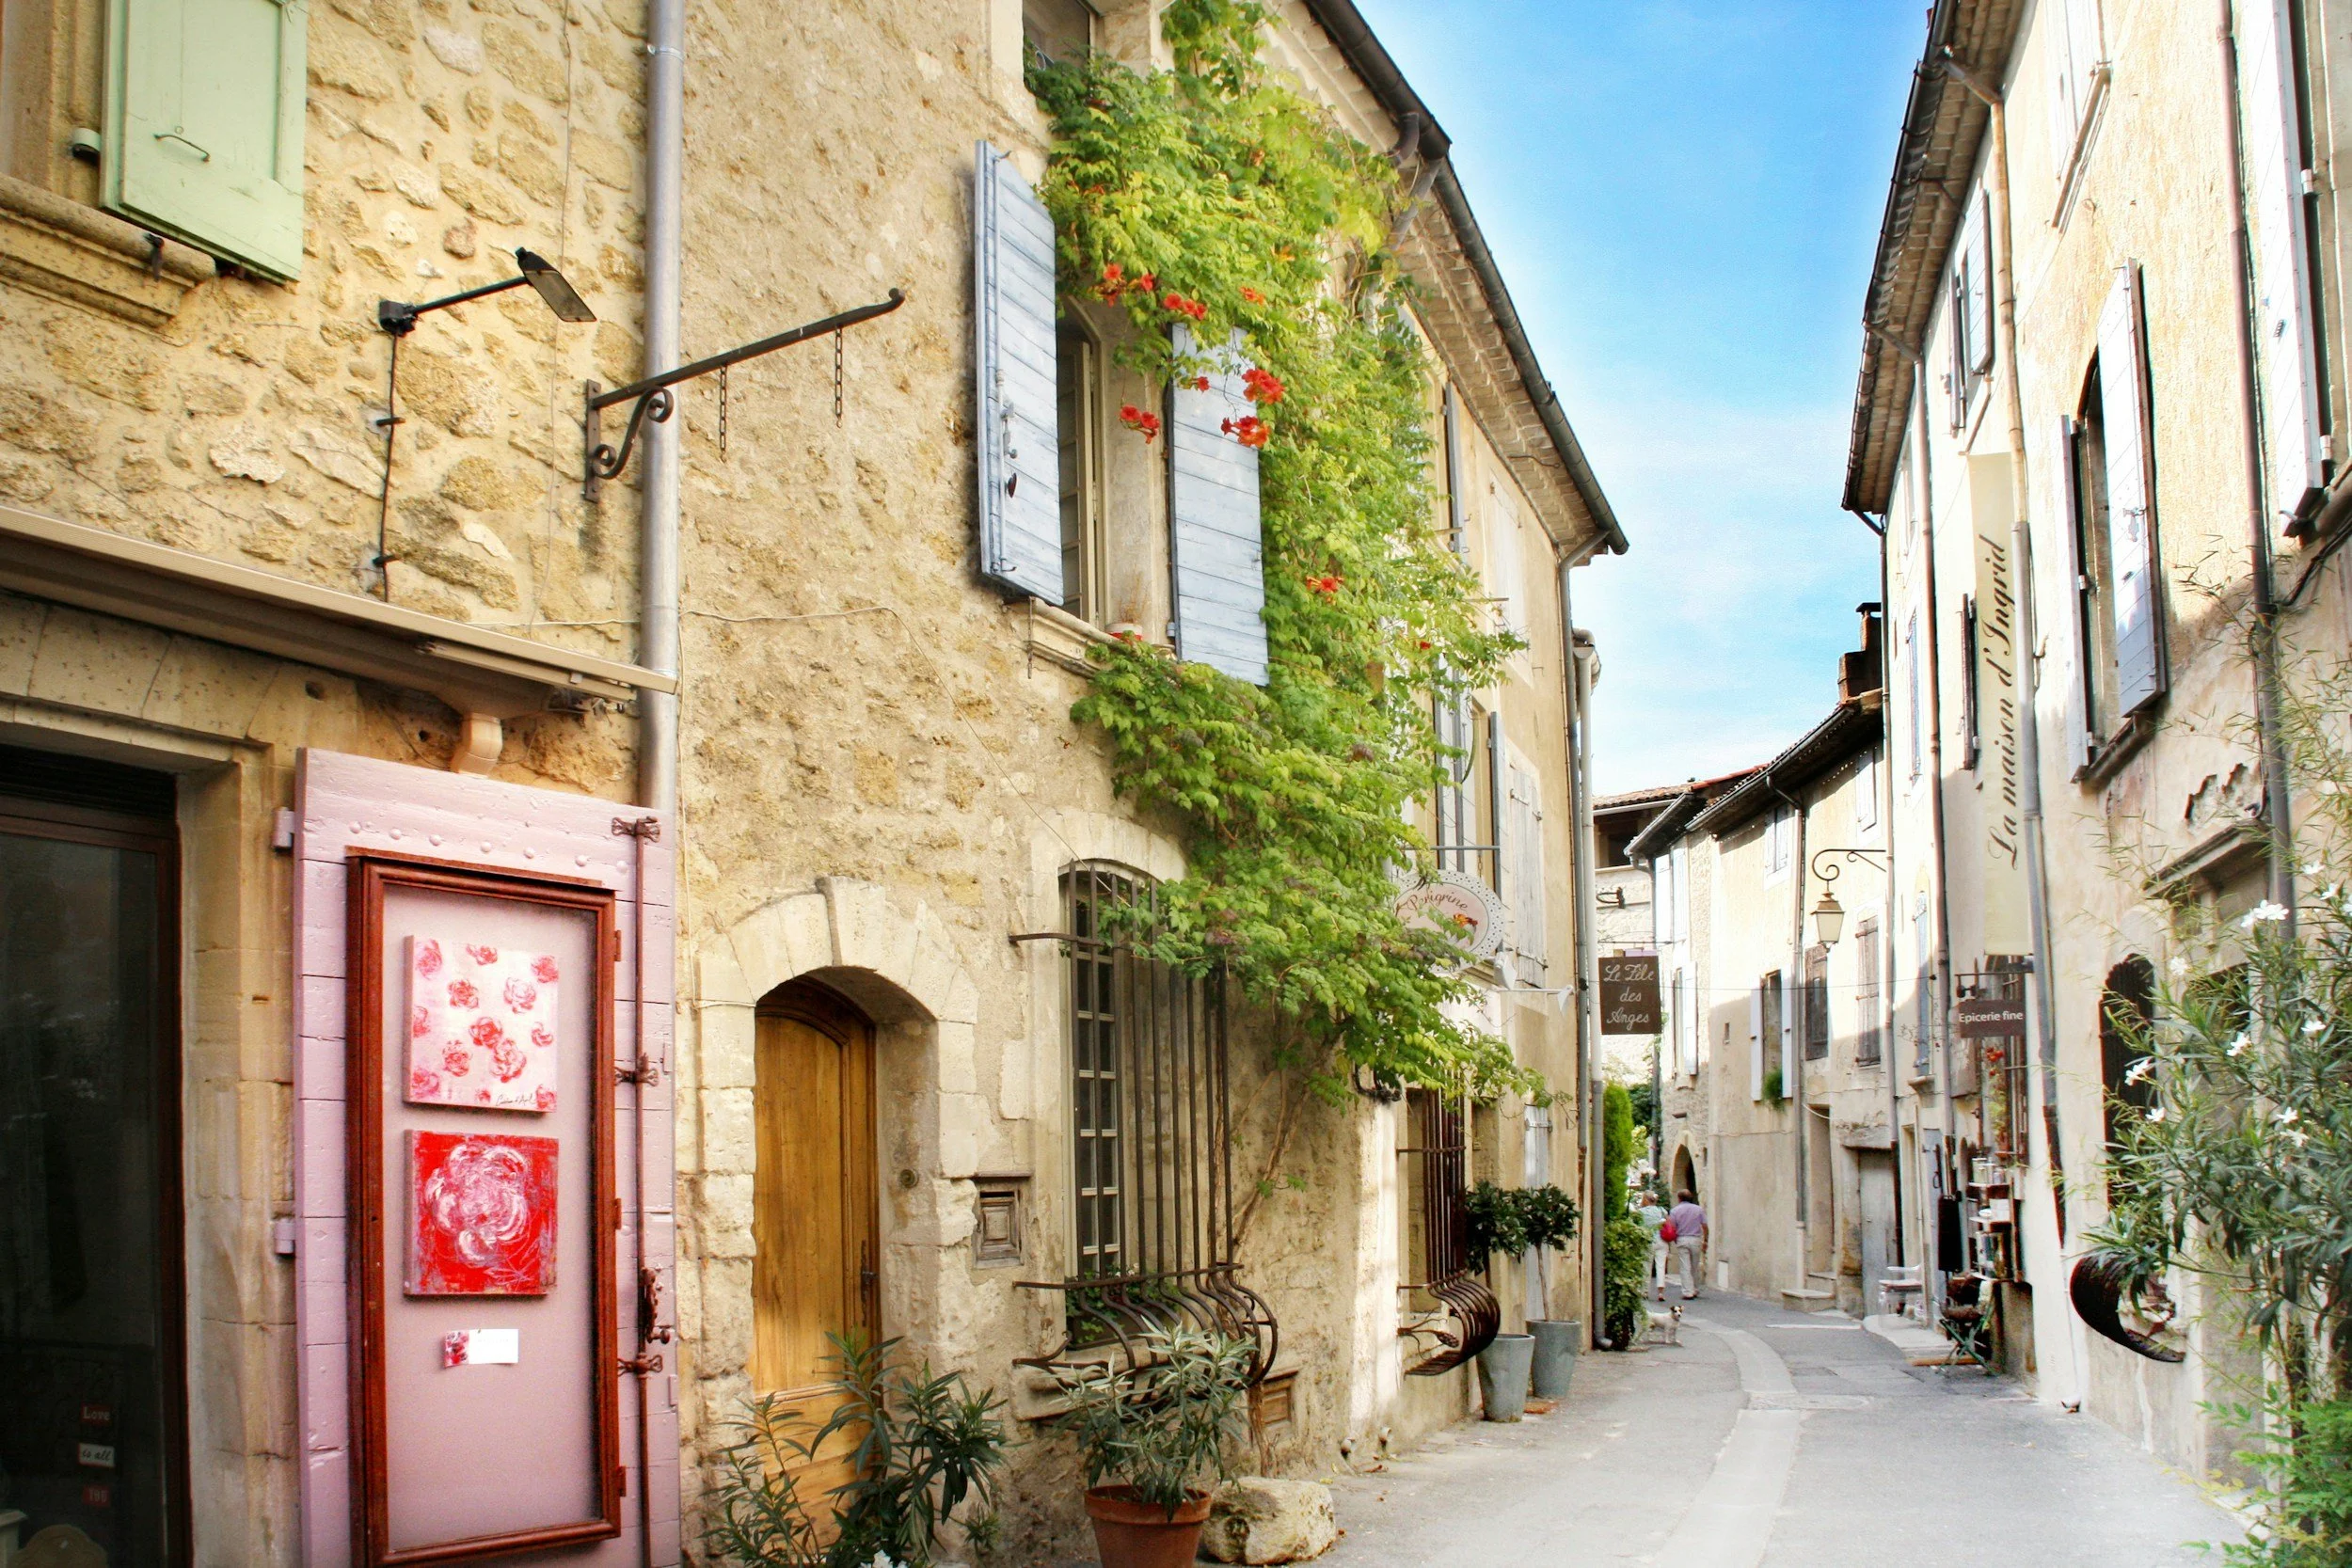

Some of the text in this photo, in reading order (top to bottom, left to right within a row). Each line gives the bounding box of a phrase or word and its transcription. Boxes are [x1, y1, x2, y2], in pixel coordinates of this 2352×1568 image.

[1979, 533, 2017, 871] La maison d'Ingrid
[1603, 964, 1621, 982] Le
[1619, 987, 1642, 1003] des
[1606, 1006, 1649, 1031] Anges
[1958, 1010, 2024, 1024] Epicerie fine
[94, 1449, 111, 1461] all
